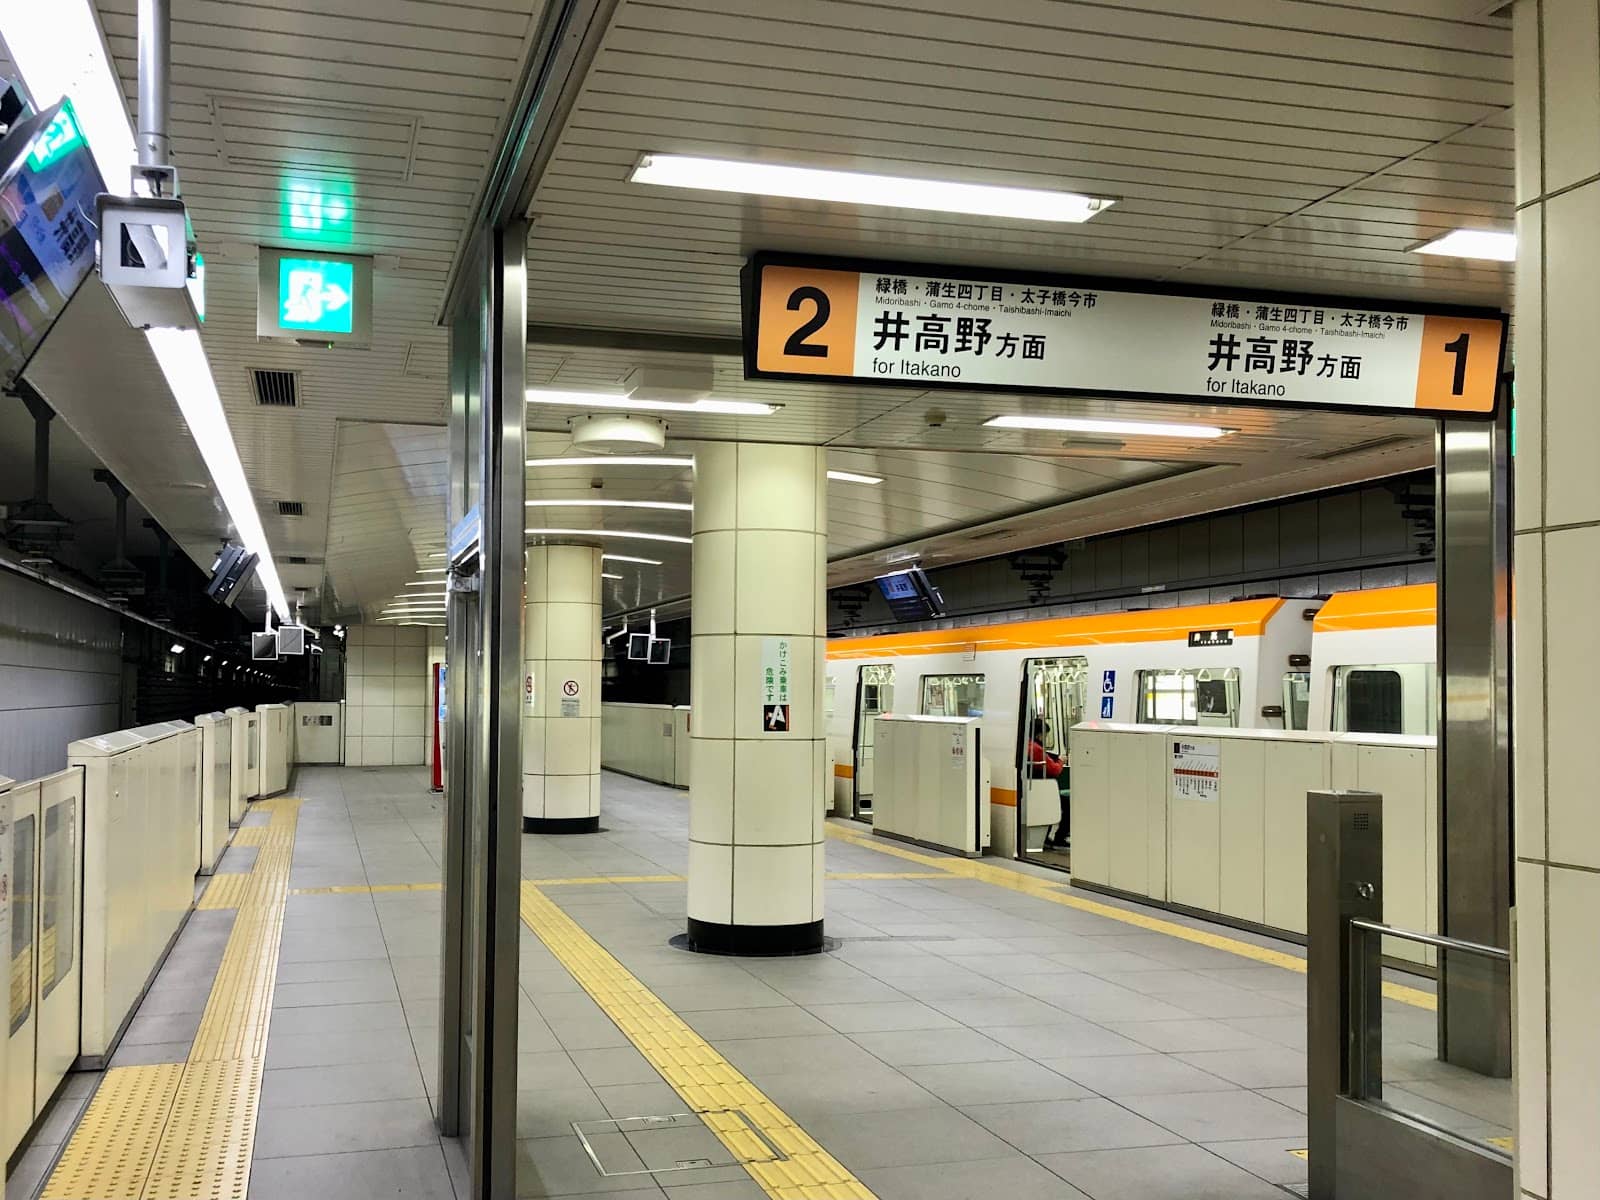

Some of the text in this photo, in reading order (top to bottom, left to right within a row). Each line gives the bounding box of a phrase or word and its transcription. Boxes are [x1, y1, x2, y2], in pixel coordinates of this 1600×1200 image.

[875, 296, 1072, 317] Midoribashi Gamo 4-chome Taishibashi-Imaichi
[783, 286, 831, 358] 2
[1210, 319, 1386, 340] Midoribashi Gamo 4-chome Taishibashi-Imaichi
[872, 358, 962, 378] for Itakano
[1444, 332, 1470, 396] 1
[1206, 377, 1286, 397] for Itakano
